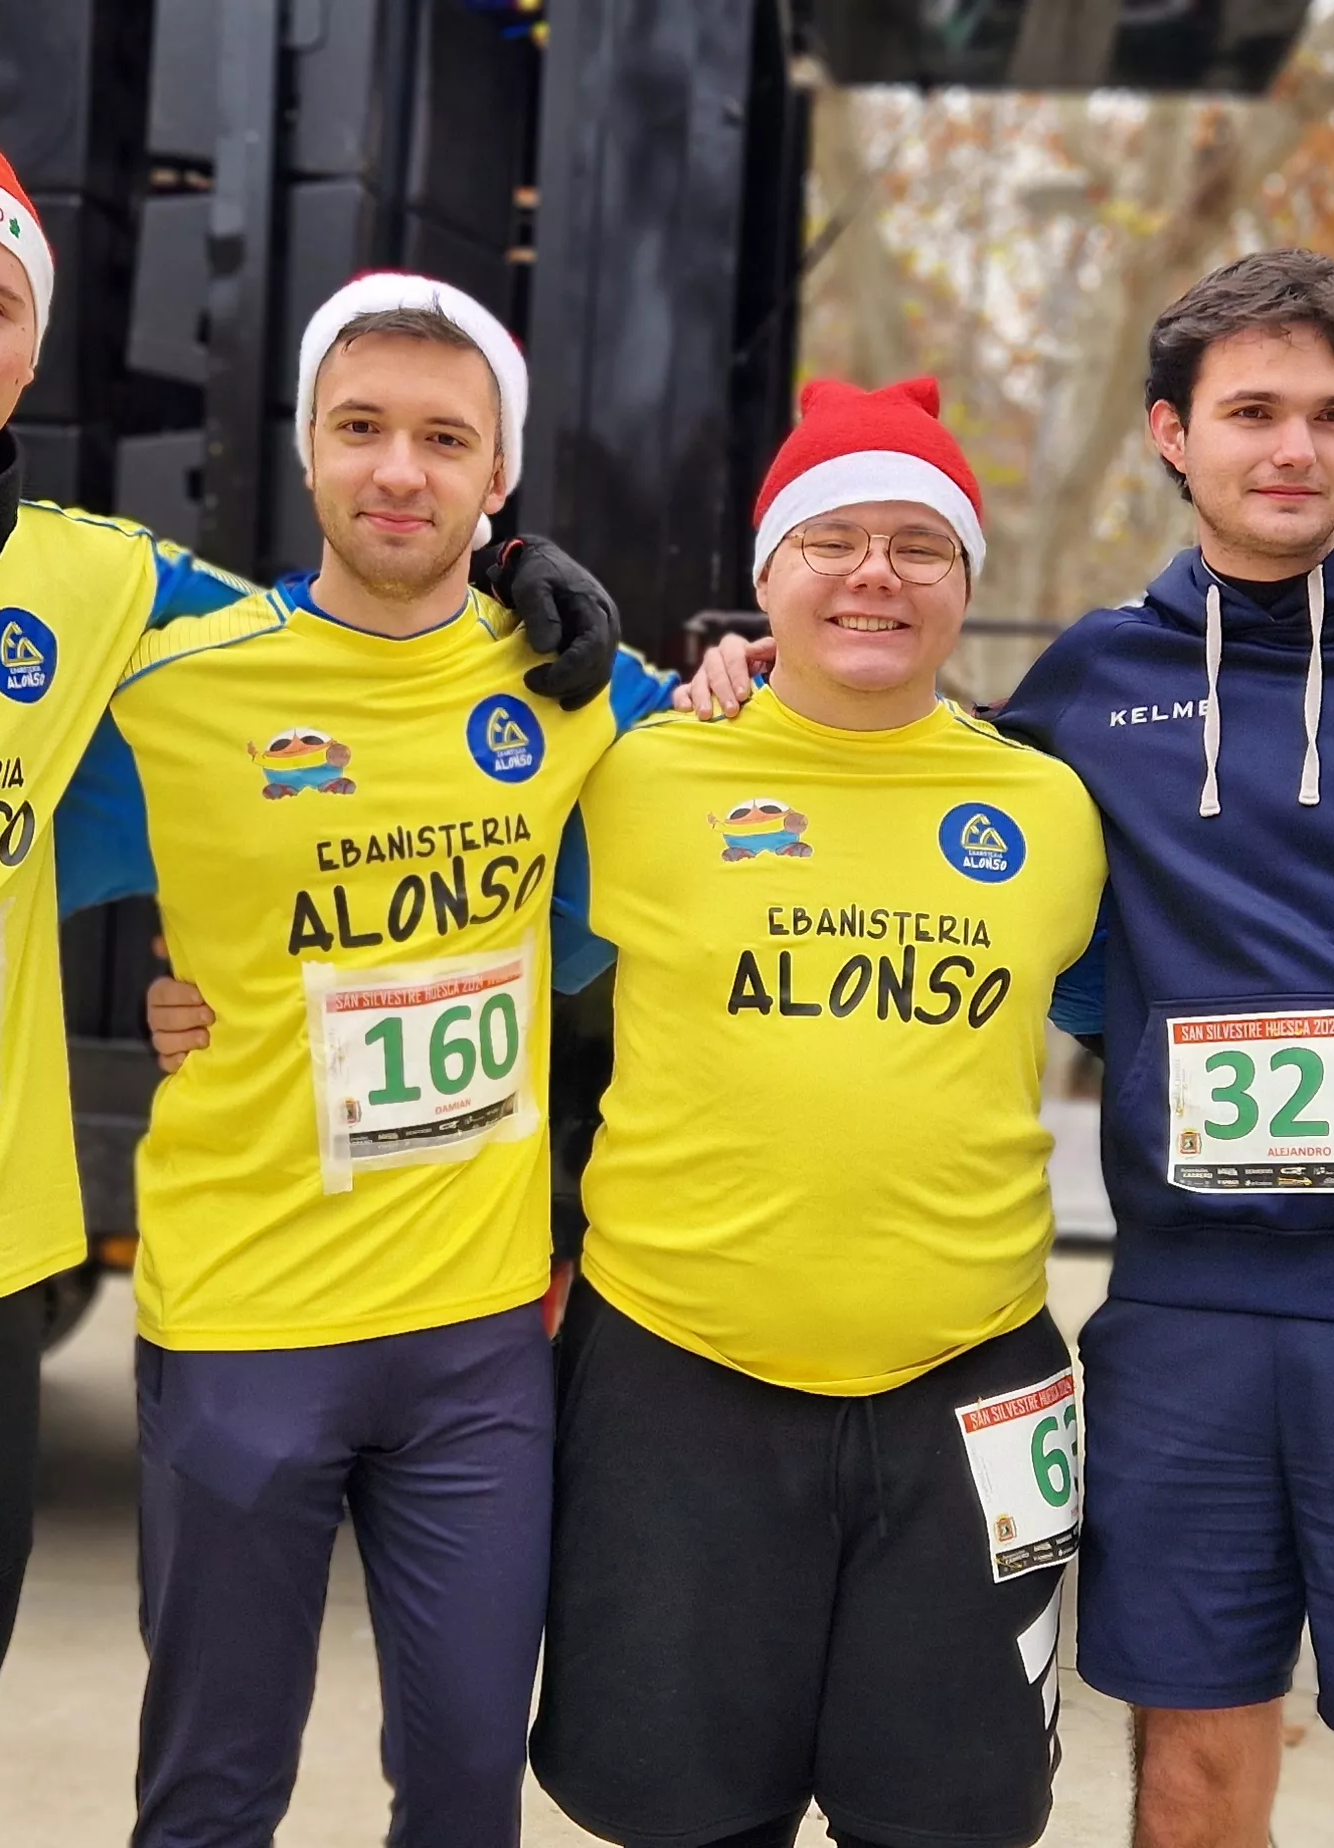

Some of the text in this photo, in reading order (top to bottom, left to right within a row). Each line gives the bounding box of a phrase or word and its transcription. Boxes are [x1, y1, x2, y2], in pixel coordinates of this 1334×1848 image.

[7, 672, 46, 689] ALONSO
[495, 753, 532, 771] ALONSO
[317, 813, 531, 871] EBANISTERIA
[963, 856, 1007, 871] ALONSO
[288, 854, 546, 955] ALONSO
[768, 904, 991, 948] EBANISTERIA
[728, 945, 1011, 1029] ALONSO
[335, 993, 358, 1009] SAN
[363, 988, 422, 1006] SILVESTRE
[1181, 1025, 1203, 1041] SAN
[1206, 1021, 1262, 1040] SILVESTRE
[1266, 1019, 1310, 1037] HUESCA
[365, 993, 519, 1106] 160
[435, 1099, 472, 1116] DAMIAN
[1267, 1146, 1332, 1157] ALEJANDRO
[970, 1408, 991, 1430] SAN
[991, 1393, 1040, 1422] SILVESTRE
